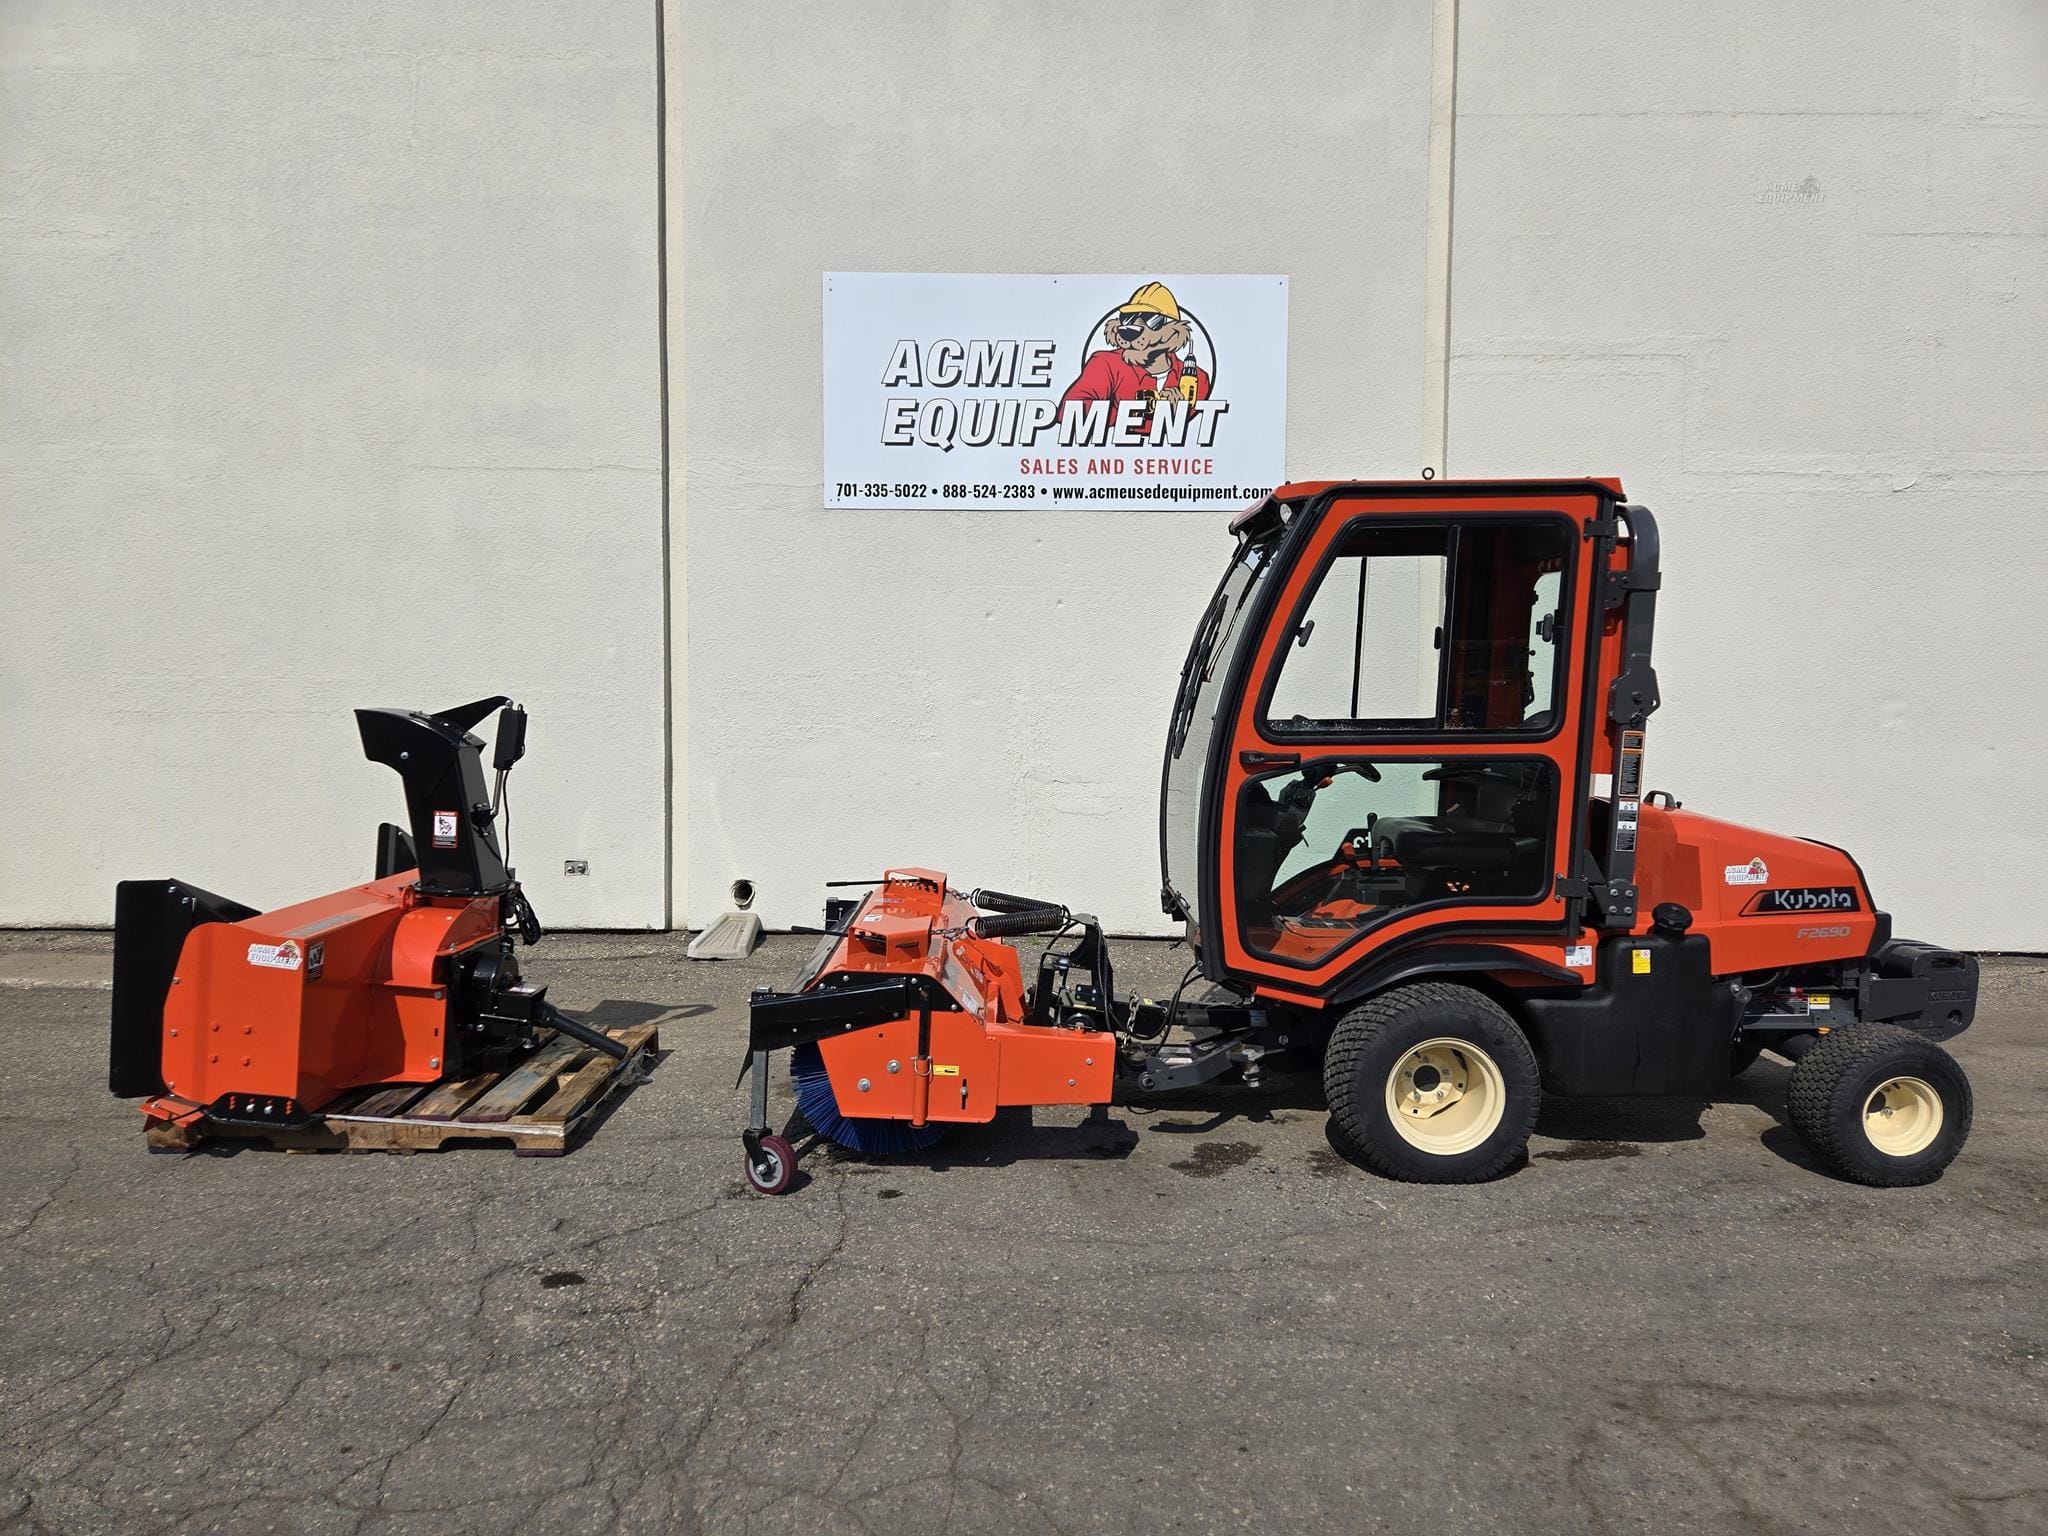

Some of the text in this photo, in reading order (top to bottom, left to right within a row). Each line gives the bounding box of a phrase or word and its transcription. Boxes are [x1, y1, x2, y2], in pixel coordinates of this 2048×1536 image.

[881, 339, 1056, 387] ACME
[881, 398, 1228, 453] EQUIPMENT
[1020, 458, 1213, 475] SALES AND SERVICE
[836, 483, 927, 498] 701-335-5022
[942, 484, 1036, 499] 888-524-2383
[1775, 888, 1851, 909] Kubota
[1797, 926, 1851, 939] F2690
